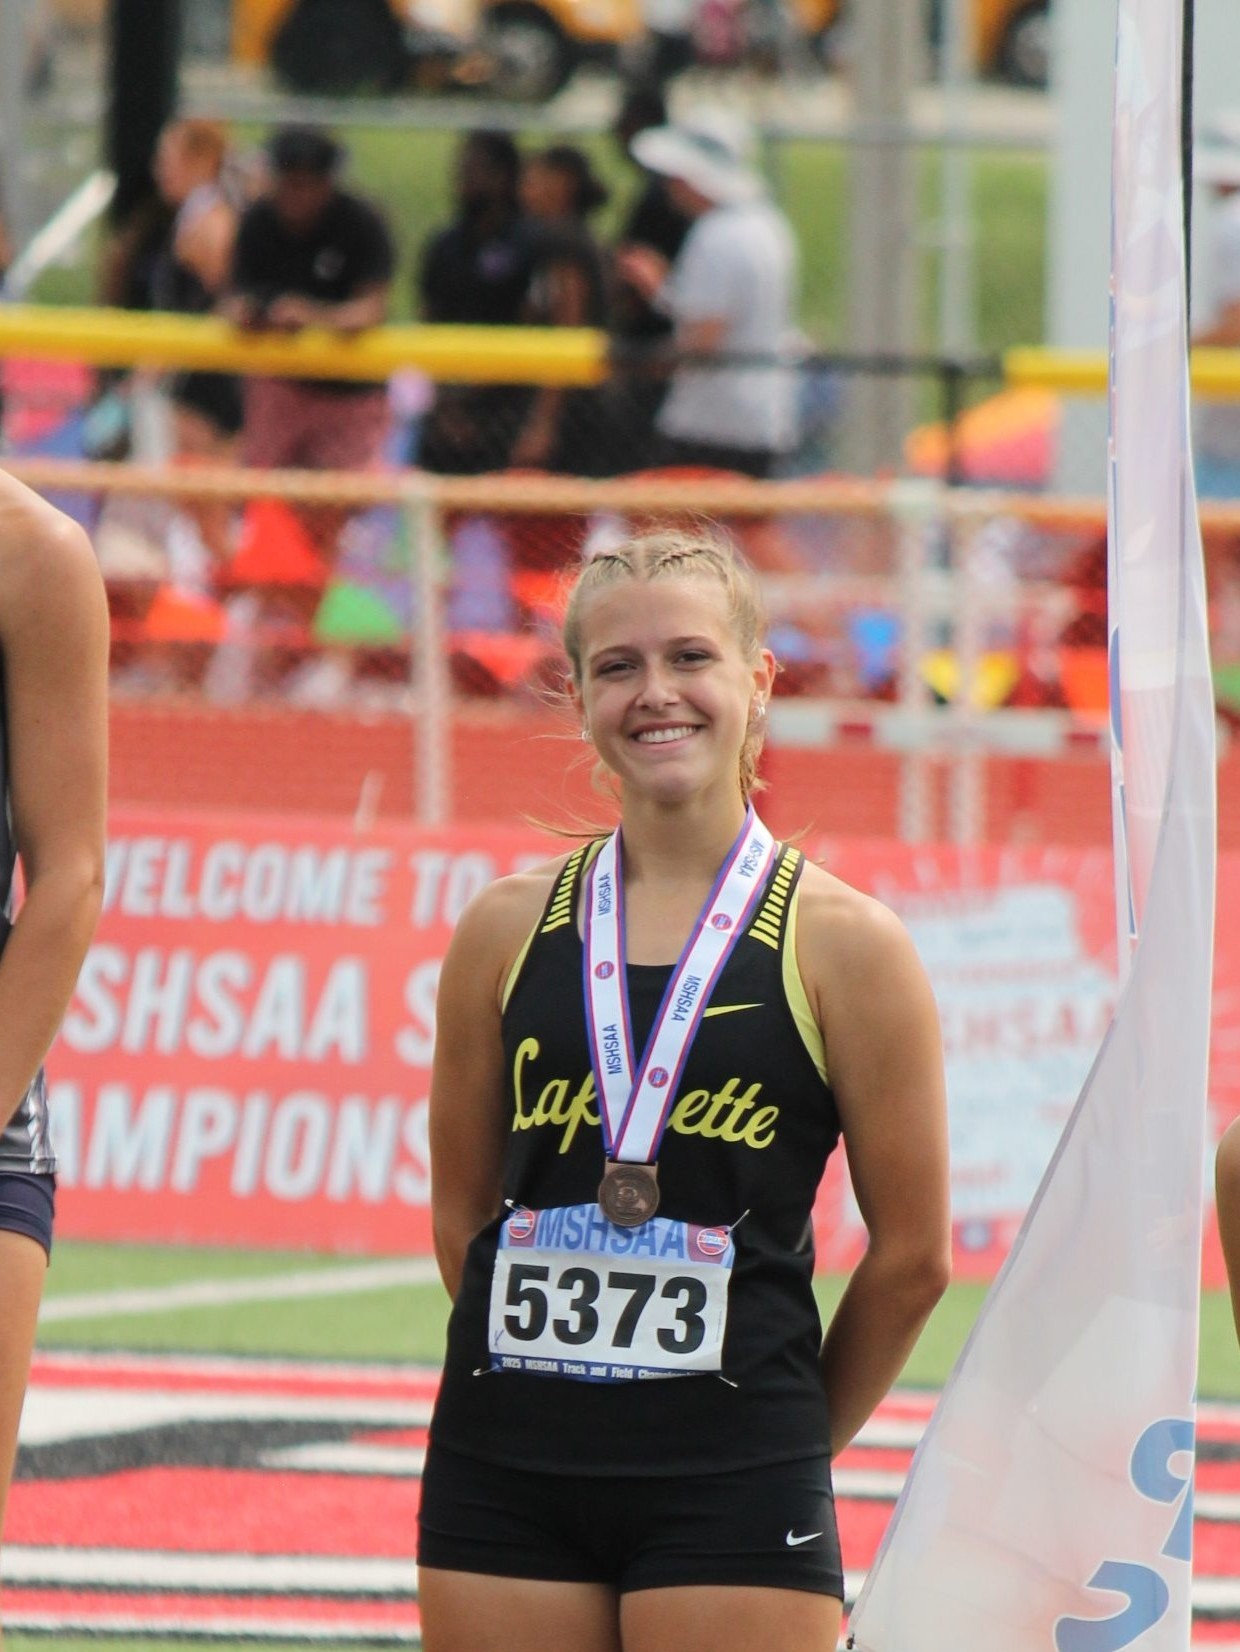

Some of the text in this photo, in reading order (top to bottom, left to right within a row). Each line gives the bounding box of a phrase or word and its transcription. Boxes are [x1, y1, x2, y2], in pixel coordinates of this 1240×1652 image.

[597, 872, 612, 916] MSHSAA
[62, 943, 369, 1065] SHSAA
[670, 974, 702, 1021] MSHSAA
[602, 1024, 623, 1075] MSHSAA
[511, 1037, 779, 1154] Lafette
[504, 1263, 707, 1354] 5373
[502, 1356, 522, 1369] 2025
[525, 1359, 559, 1373] MSHSAA
[563, 1362, 586, 1375] Track
[590, 1365, 607, 1377] and
[611, 1367, 633, 1379] Field
